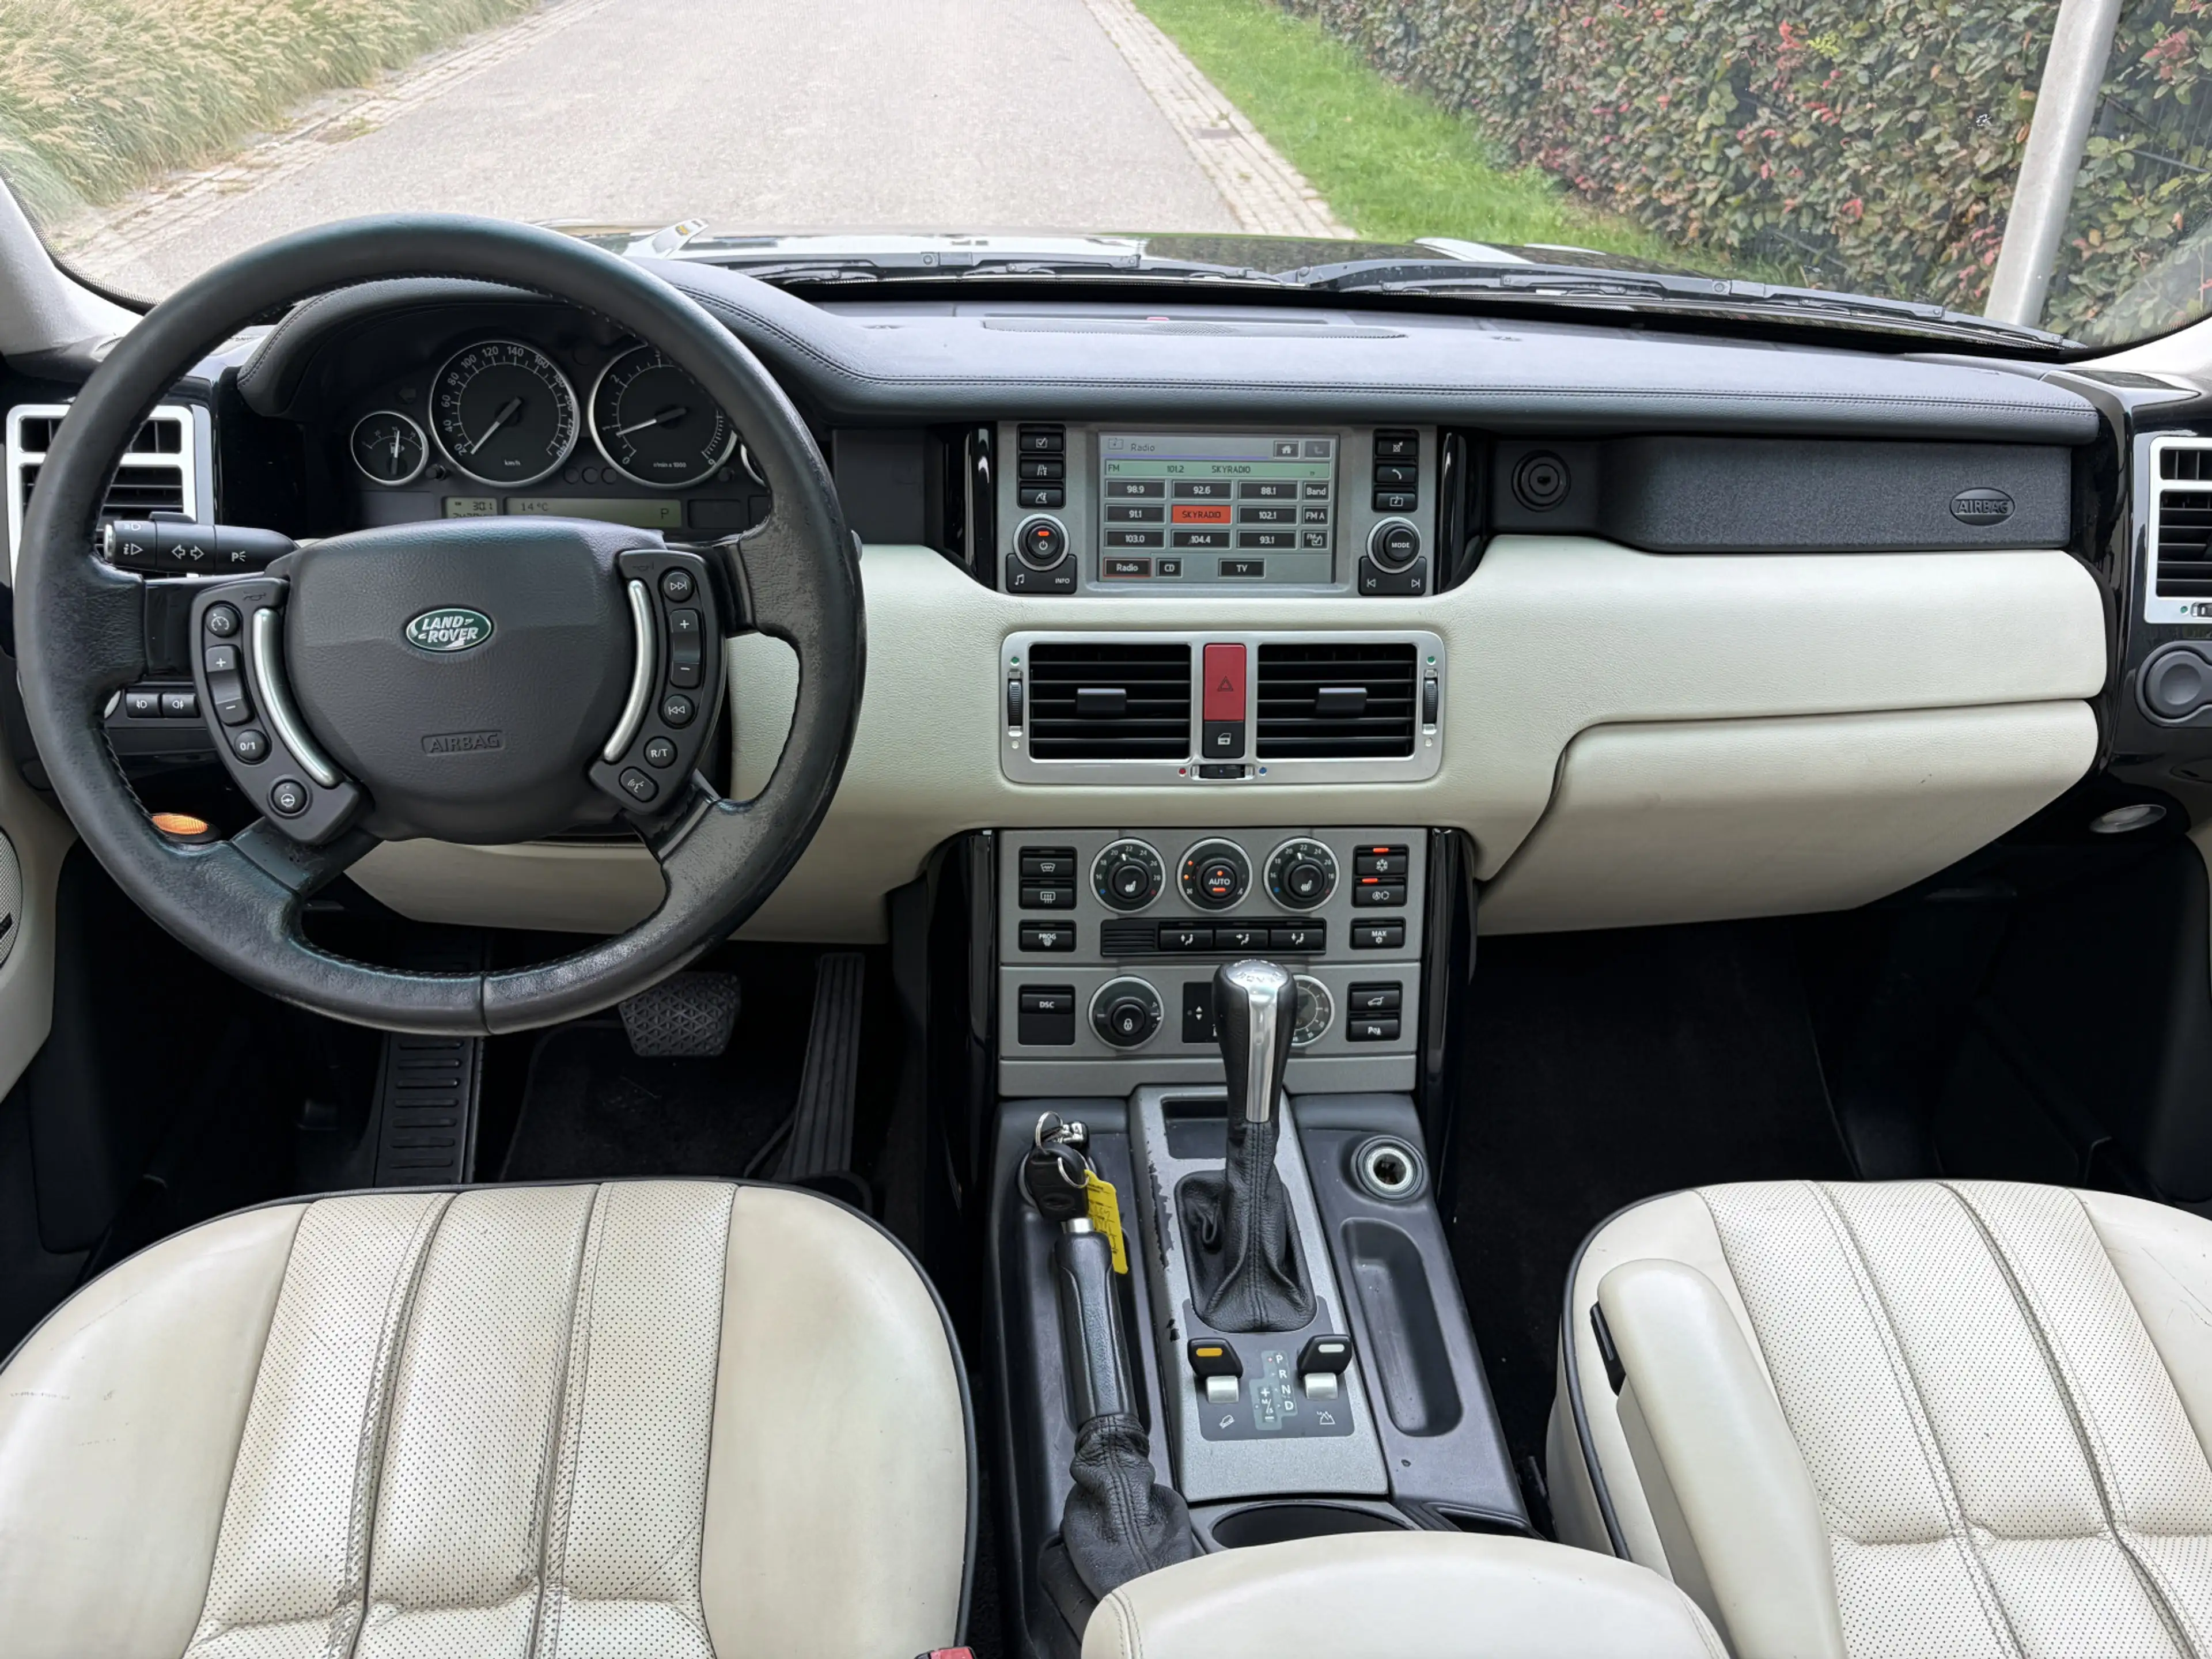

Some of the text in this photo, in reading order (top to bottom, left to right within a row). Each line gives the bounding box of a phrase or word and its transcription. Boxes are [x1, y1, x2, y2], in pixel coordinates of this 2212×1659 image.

[482, 346, 499, 357] 120
[507, 346, 524, 357] 140
[461, 354, 477, 369] 100
[535, 354, 549, 369] 160
[447, 372, 460, 385] 80
[552, 374, 566, 388] 180
[610, 374, 620, 383] 2
[441, 395, 450, 407] 60
[443, 419, 453, 432] 40
[454, 443, 468, 456] 20
[1130, 443, 1156, 452] Radio
[622, 457, 630, 465] 0
[1211, 465, 1251, 474] SKYRADIO
[1126, 485, 1145, 494] 98.9
[1193, 486, 1211, 495] 92.6
[1306, 487, 1327, 495] Band
[521, 502, 534, 512] 14
[1956, 499, 2009, 514] AIRBAG
[660, 507, 669, 519] P
[1182, 510, 1221, 518] SKYRADIO
[1305, 512, 1325, 520] FM A
[1125, 535, 1145, 543] 103.0
[1116, 563, 1139, 572] Radio
[1164, 564, 1175, 572] CD
[422, 616, 464, 630] LAND
[427, 627, 479, 643] ROVER
[239, 742, 256, 751] 0/1
[430, 732, 500, 753] AIRBAG
[650, 748, 668, 758] R/T
[1209, 877, 1231, 885] AUTO
[1275, 1354, 1283, 1364] P
[1279, 1370, 1287, 1378] R
[1281, 1384, 1291, 1394] N
[1285, 1401, 1294, 1411] D
